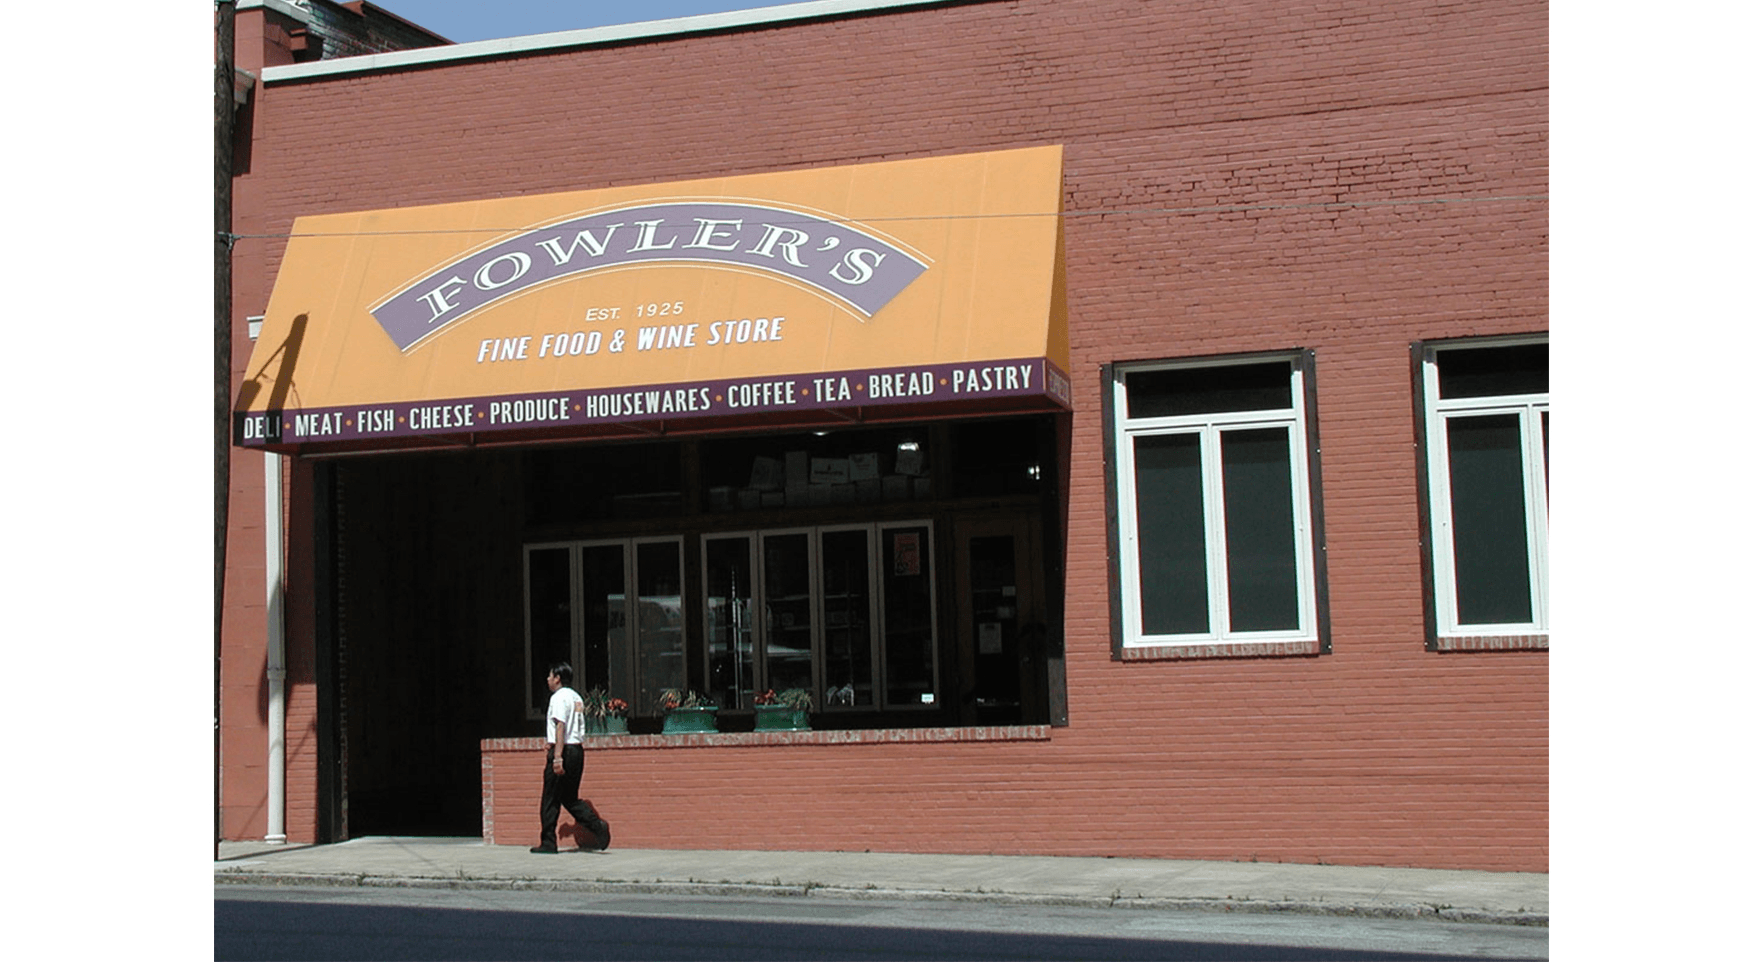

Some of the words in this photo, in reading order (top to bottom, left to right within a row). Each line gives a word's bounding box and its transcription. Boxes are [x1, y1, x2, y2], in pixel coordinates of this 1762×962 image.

[416, 218, 887, 323] FOWLER'S
[477, 336, 530, 363] FINE
[538, 331, 602, 357] FOOD
[609, 329, 625, 353] &
[637, 323, 699, 351] WINE
[707, 317, 785, 345] STORE
[585, 307, 621, 321] EST.
[636, 301, 684, 318] 1925
[243, 416, 280, 439] DELI
[295, 412, 343, 437] MEAT
[357, 410, 394, 433] FISH
[409, 404, 474, 430] CHEESE
[490, 397, 570, 424] PRODUCE
[587, 387, 710, 418] HOUSEWARES
[728, 380, 796, 408] COFFEE
[813, 377, 851, 402] TEA
[869, 371, 934, 399] BREAD
[953, 364, 1032, 393] PASTRY
